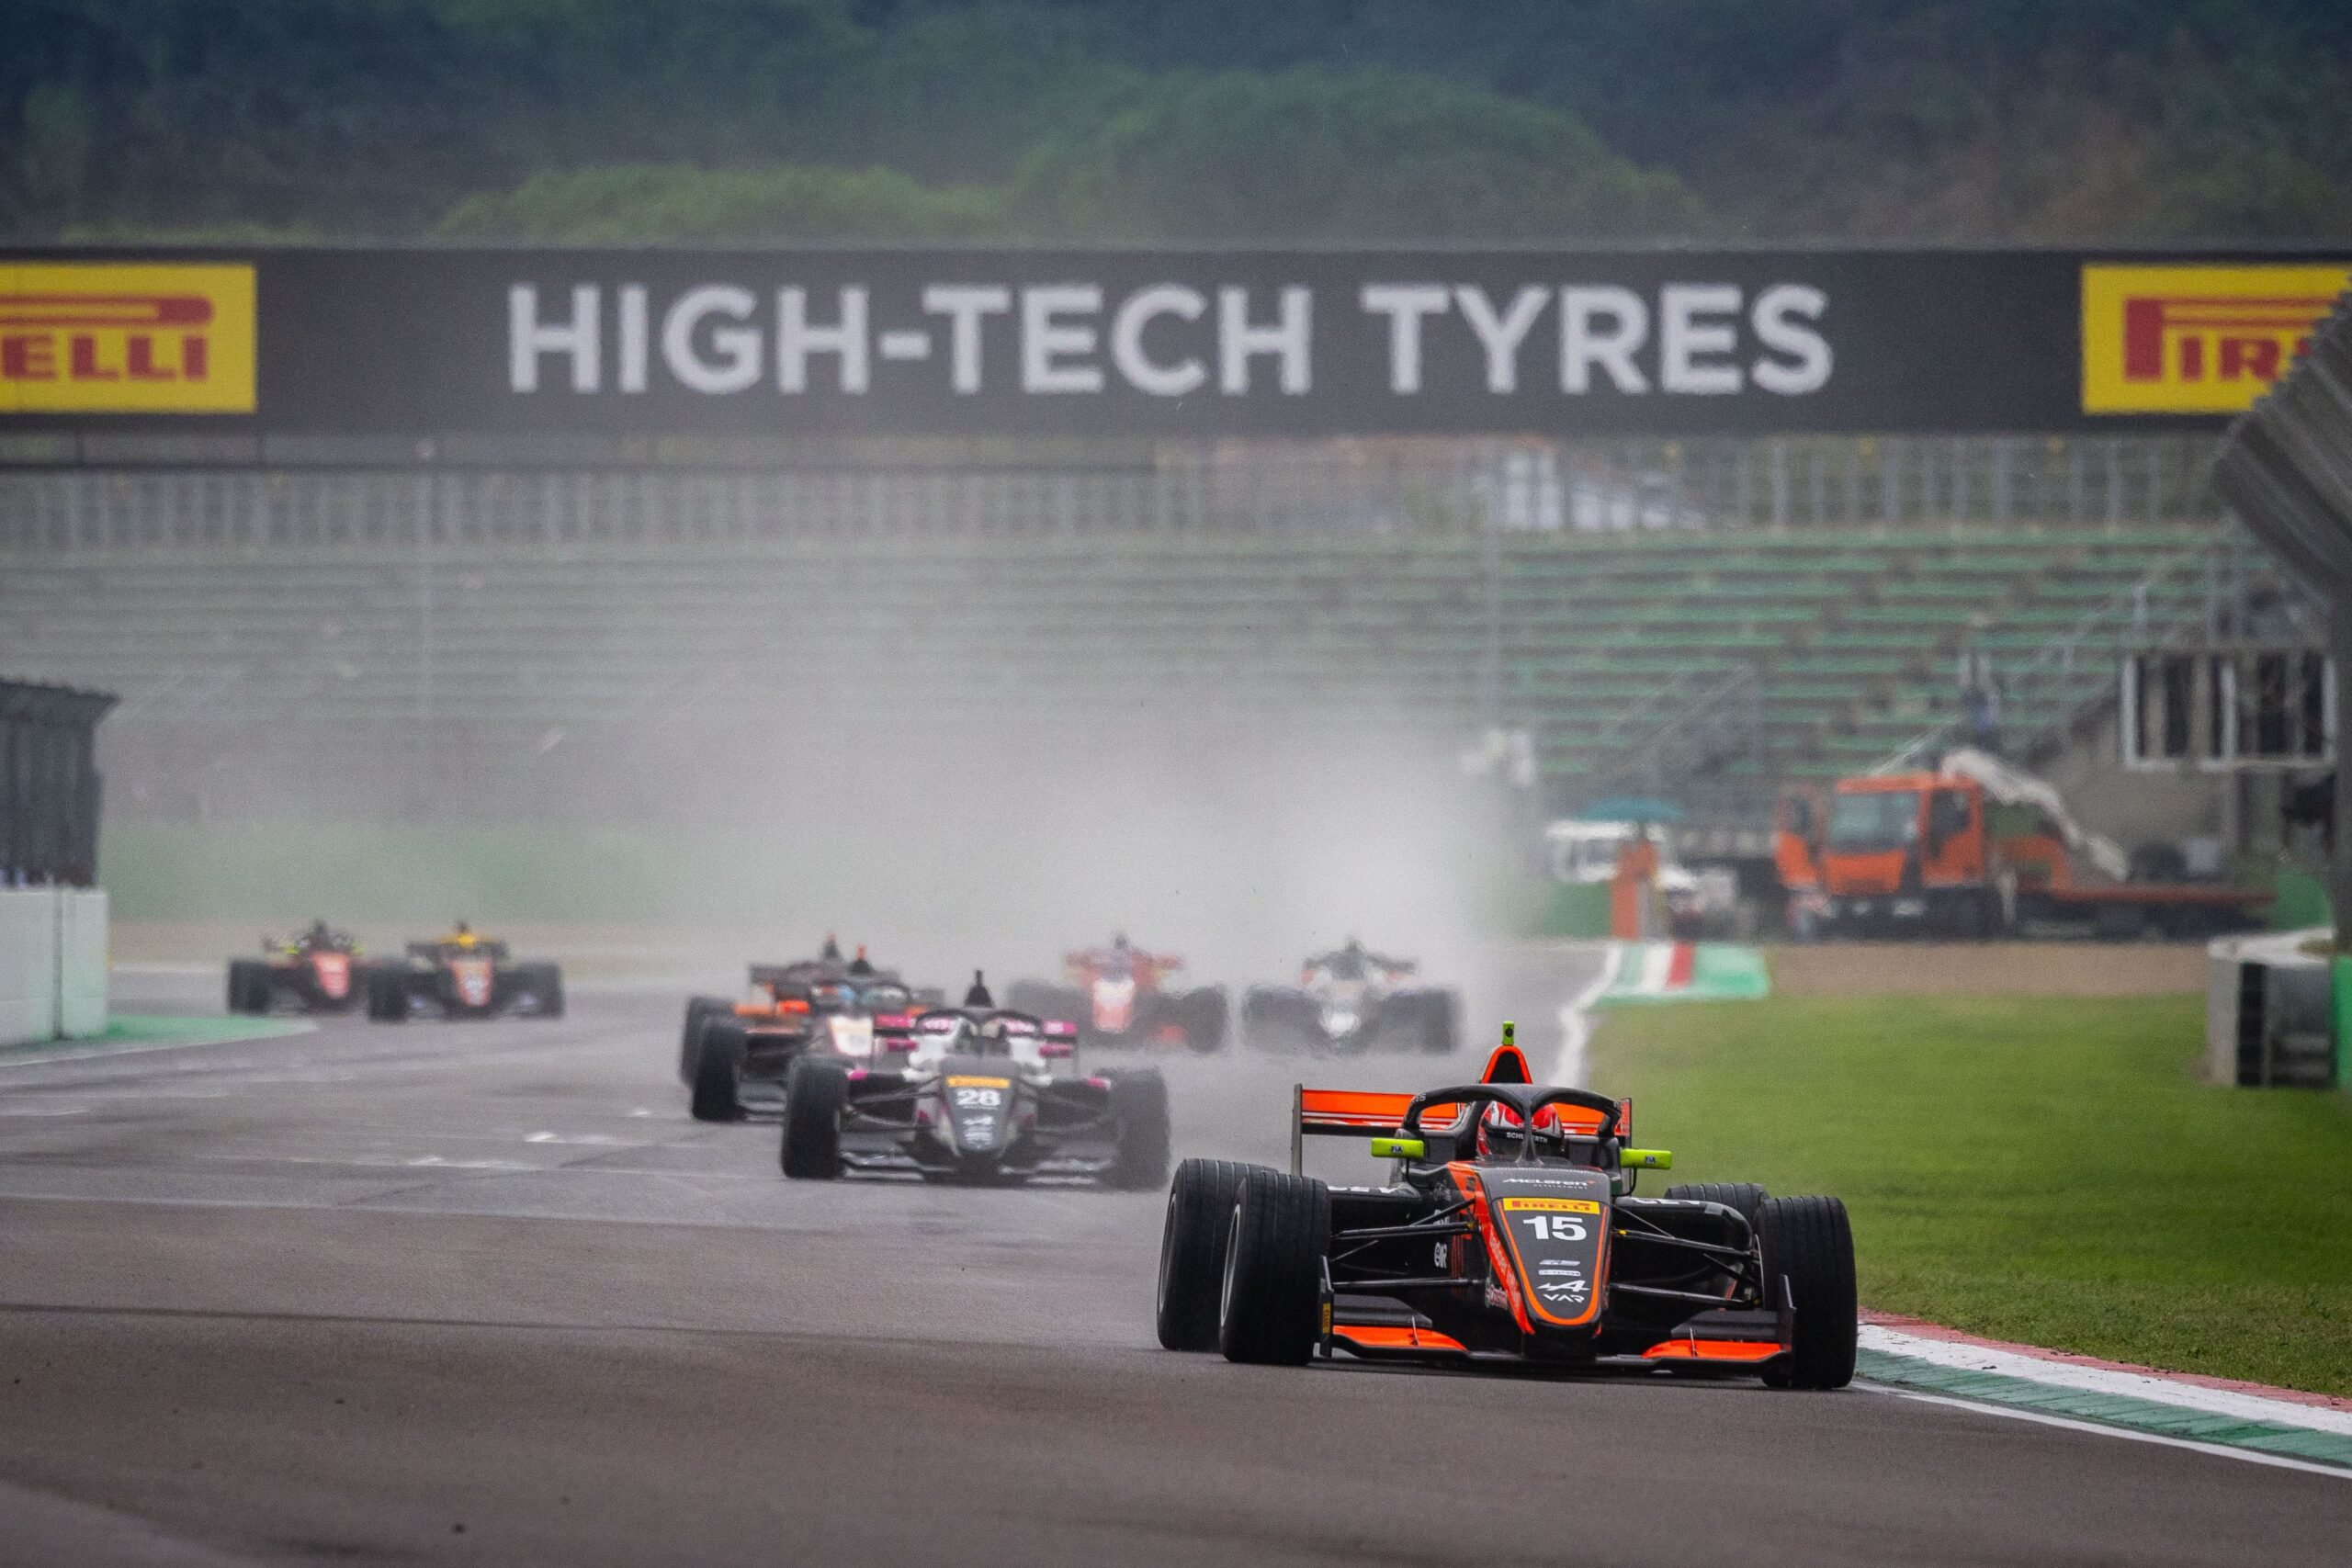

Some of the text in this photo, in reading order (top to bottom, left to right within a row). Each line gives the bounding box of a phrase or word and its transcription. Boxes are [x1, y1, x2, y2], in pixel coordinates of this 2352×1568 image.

[508, 283, 1836, 396] HIGH-TECH TYRES
[2122, 295, 2324, 383] PIR
[956, 1089, 1001, 1106] 28
[1522, 1215, 1588, 1241] 15
[1543, 1293, 1586, 1303] VAR
